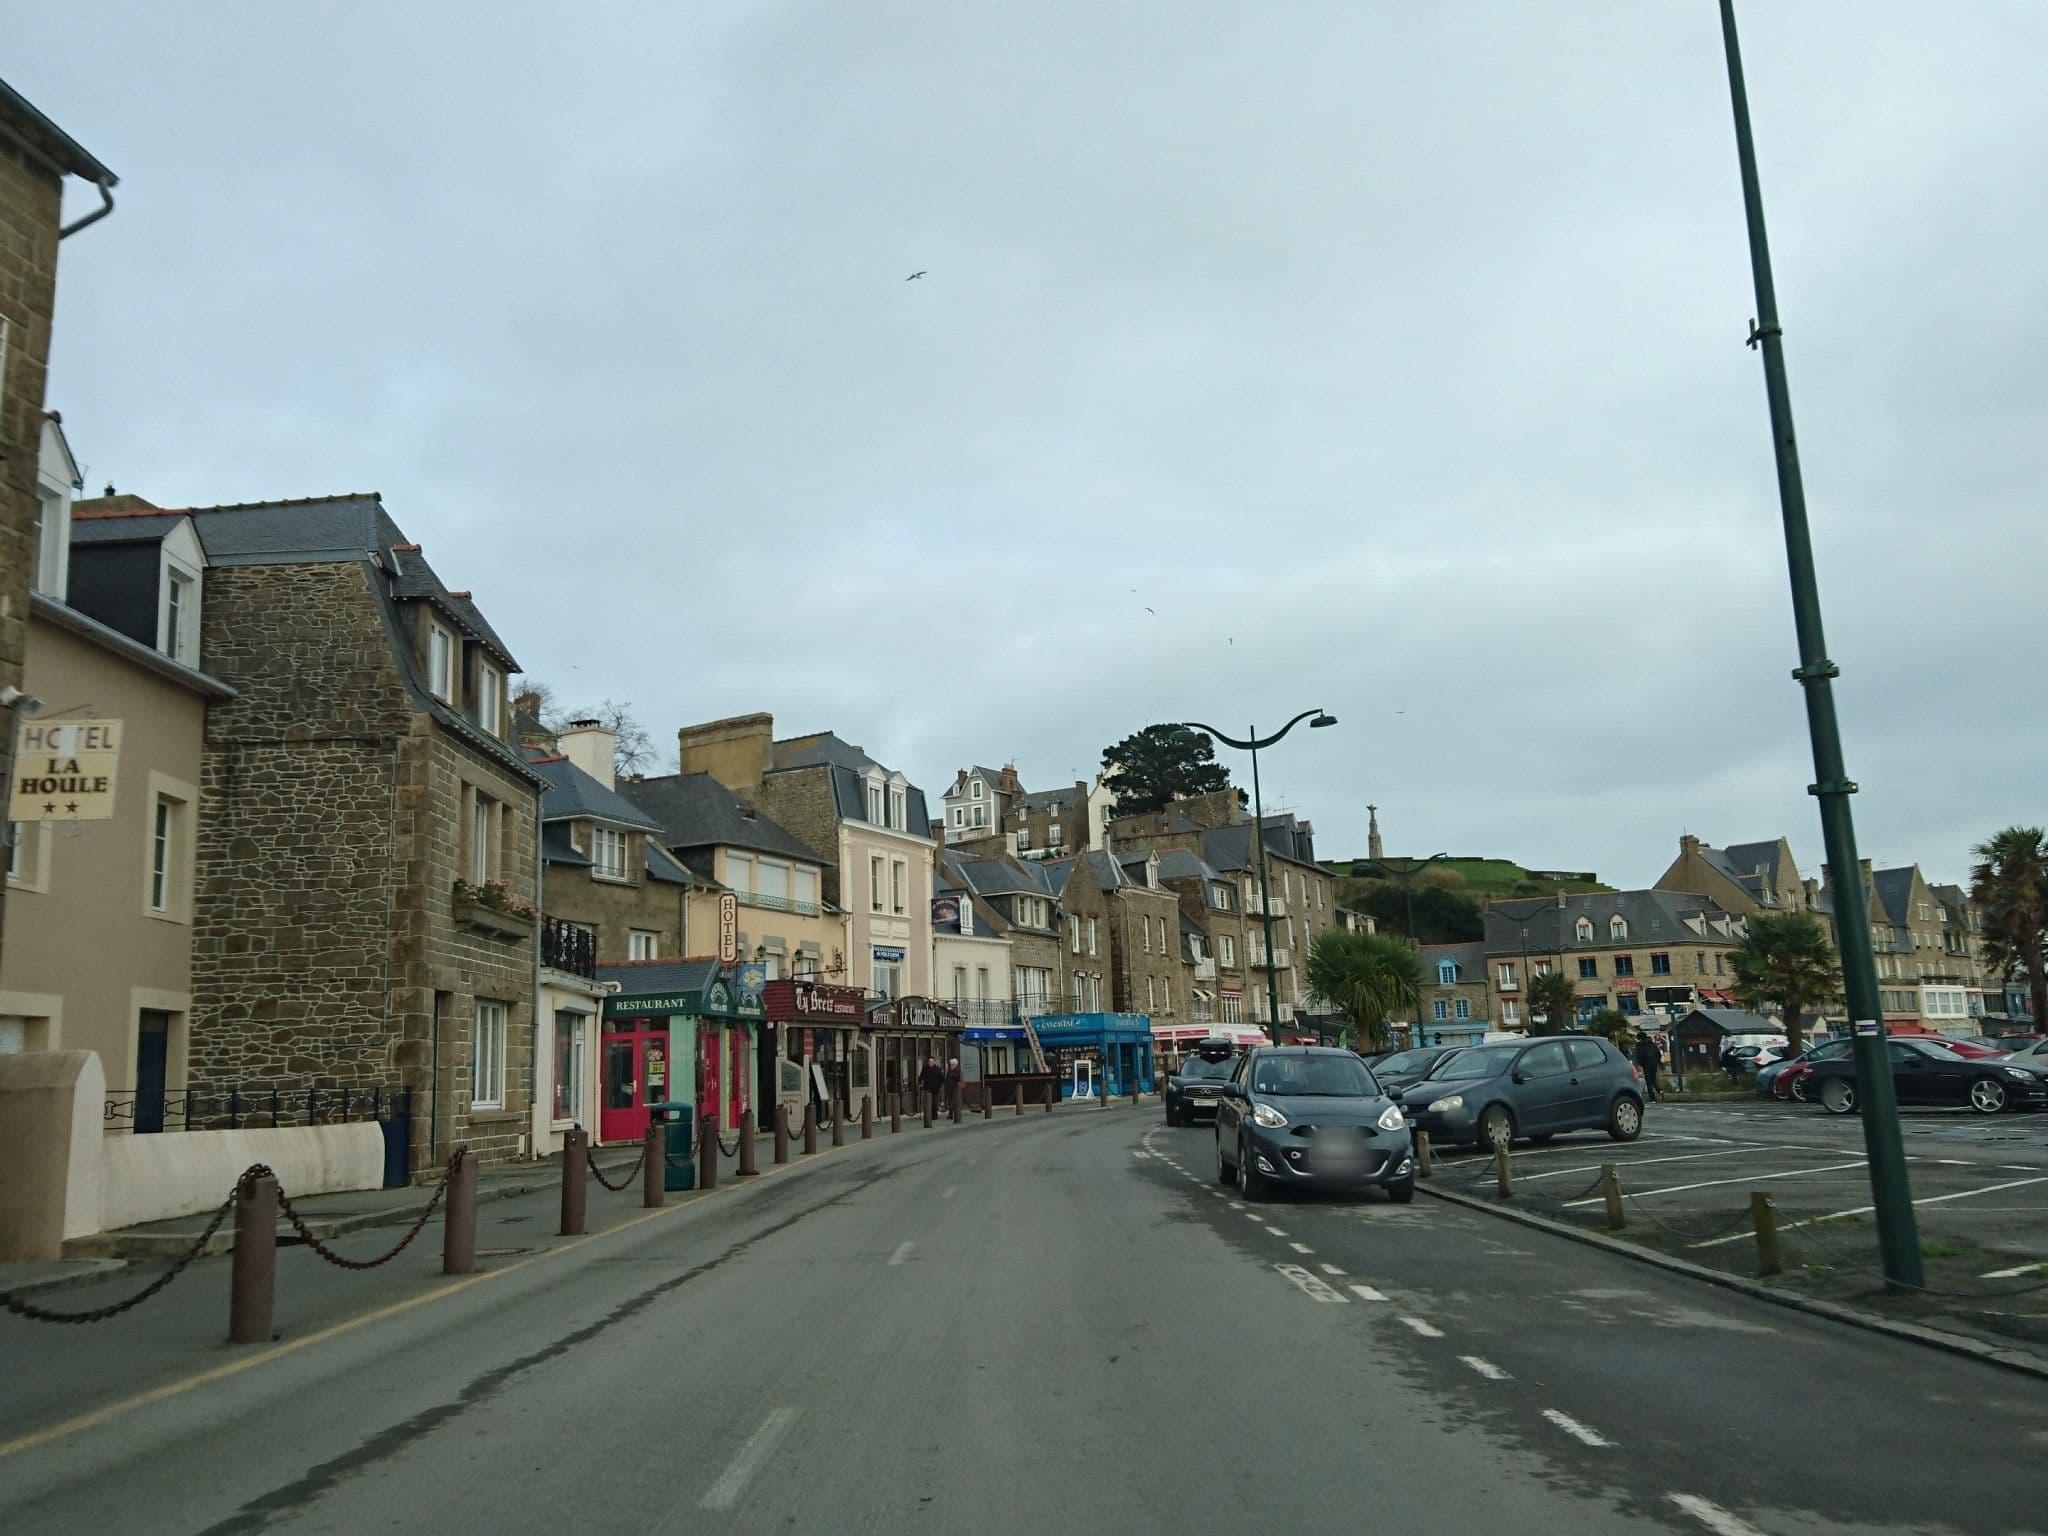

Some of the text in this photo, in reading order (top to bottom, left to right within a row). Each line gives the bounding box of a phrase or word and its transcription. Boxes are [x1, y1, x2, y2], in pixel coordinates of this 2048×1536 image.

[25, 726, 112, 750] HOEL
[47, 758, 81, 774] LA
[20, 776, 108, 795] HOULE
[723, 898, 734, 958] HOTEL
[615, 998, 685, 1011] RESTAURANT
[810, 990, 834, 1012] Breiz
